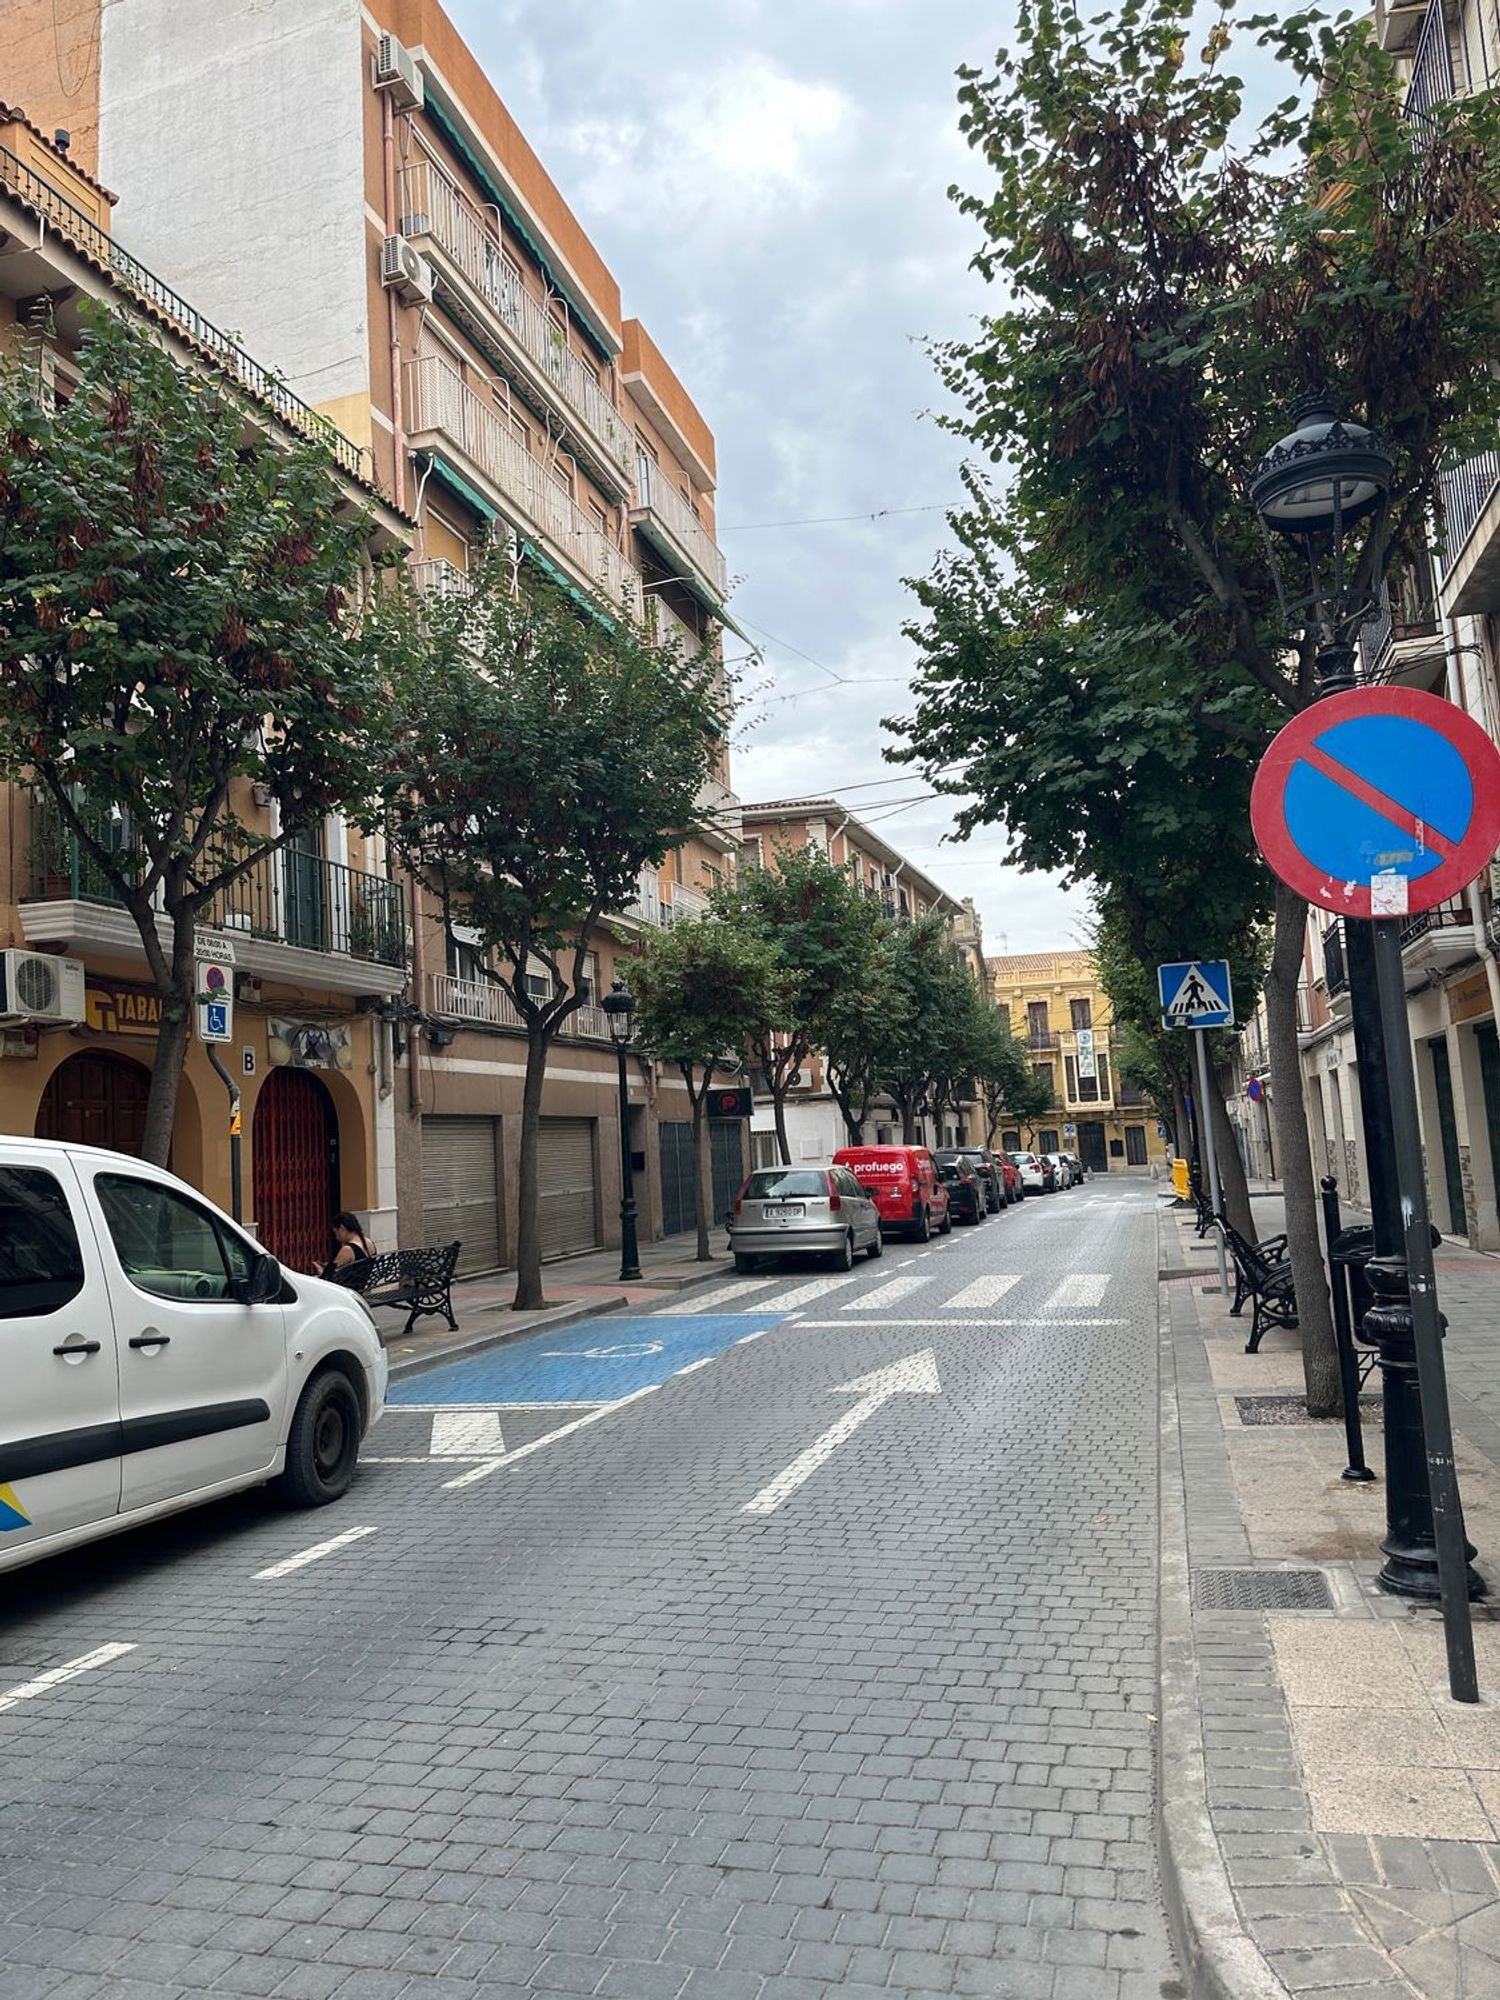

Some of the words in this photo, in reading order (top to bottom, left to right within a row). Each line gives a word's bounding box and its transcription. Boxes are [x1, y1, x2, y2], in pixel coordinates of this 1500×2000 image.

[197, 937, 206, 946] DE
[211, 951, 232, 961] HORAS
[245, 1053, 254, 1071] B
[854, 1161, 903, 1173] profuego
